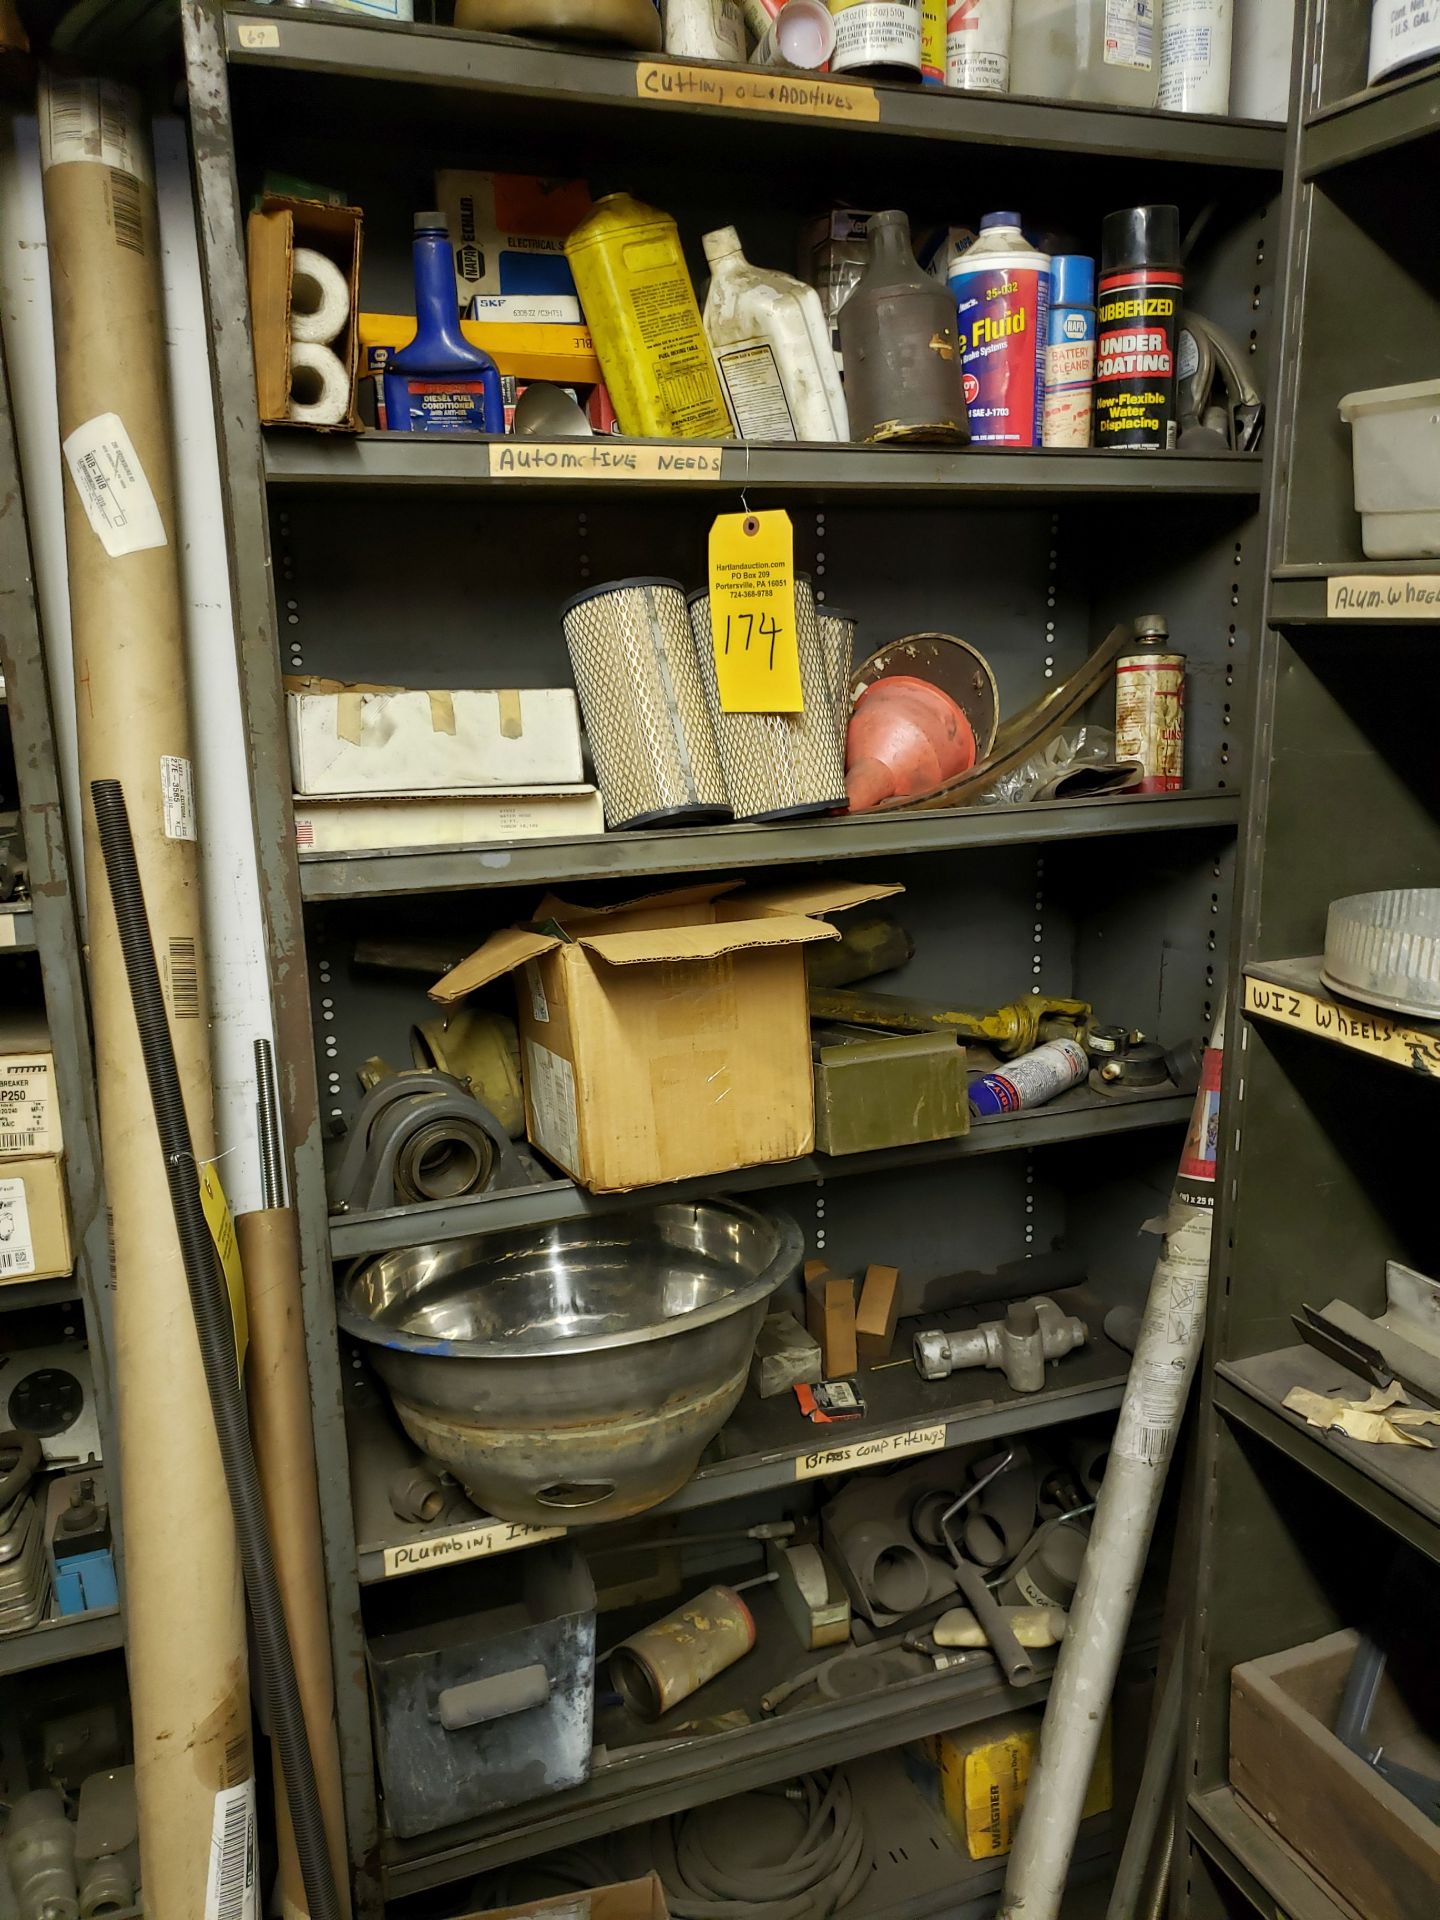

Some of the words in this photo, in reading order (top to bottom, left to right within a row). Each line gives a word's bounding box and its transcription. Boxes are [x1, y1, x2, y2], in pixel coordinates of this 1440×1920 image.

[876, 20, 904, 30] FLAMMABLE
[508, 237, 554, 250] ELECTRICAL
[464, 248, 478, 276] NAPA
[986, 282, 1019, 301] 35-032
[480, 299, 506, 307] SKF
[972, 307, 1025, 347] Fluid
[1067, 320, 1085, 333] NAPA
[1100, 334, 1162, 357] UNDER
[1052, 347, 1088, 362] BATTERY
[1052, 360, 1089, 374] CLEANER
[422, 401, 475, 409] CONDITIONER
[423, 394, 452, 402] DIESEL
[1109, 406, 1146, 418] Water
[1100, 417, 1159, 432] Displacing
[658, 455, 720, 471] NEEDS
[83, 452, 97, 469] NIB
[94, 474, 108, 491] NIB
[716, 561, 785, 571] Hartlandauction.com
[715, 582, 755, 590] Portersville,
[724, 612, 783, 671] 174
[1253, 986, 1301, 1018] WIZ
[1196, 1196, 1207, 1205] 25
[985, 1784, 1001, 1850] WAGNER
